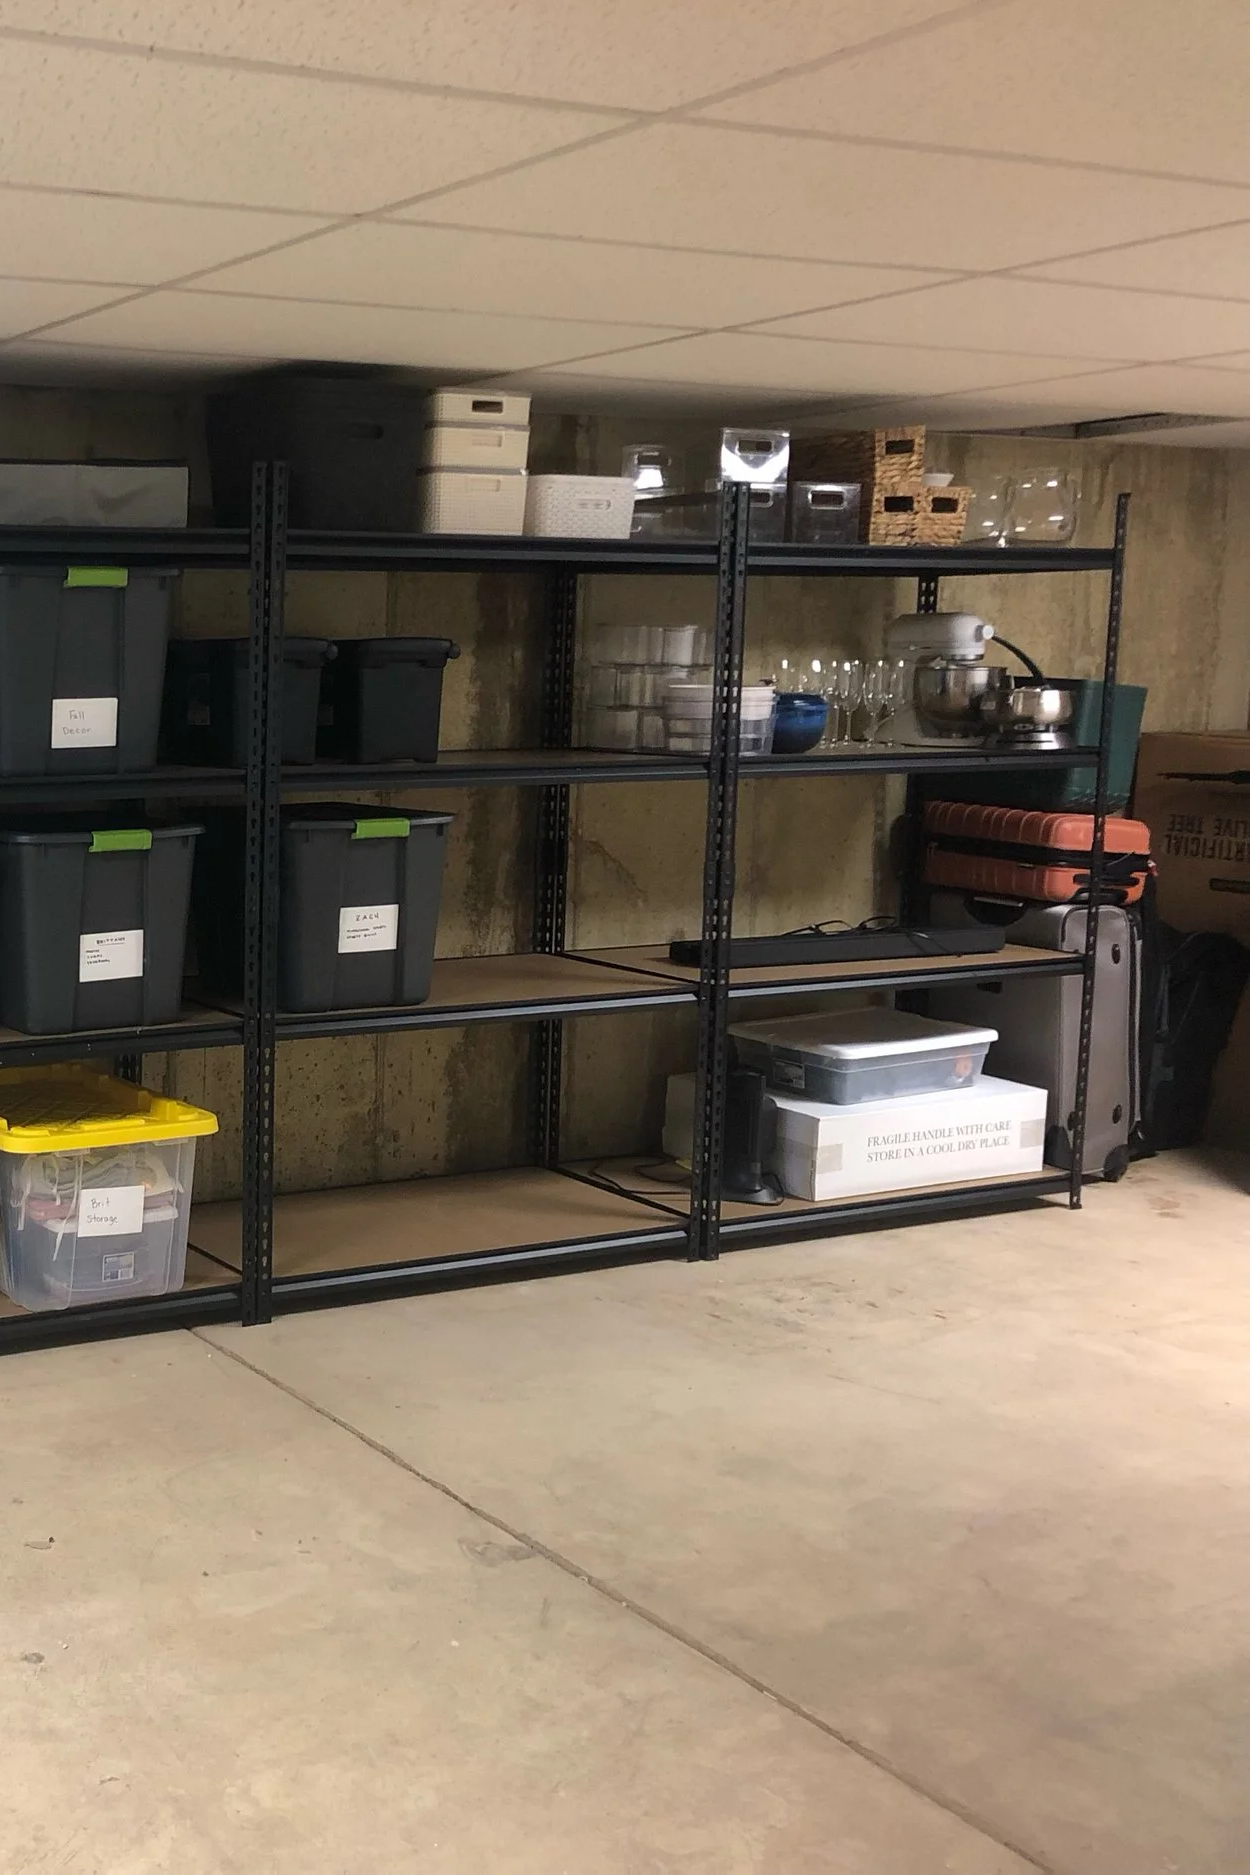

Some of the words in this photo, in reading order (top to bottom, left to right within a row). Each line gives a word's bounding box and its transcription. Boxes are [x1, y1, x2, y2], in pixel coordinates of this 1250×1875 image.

[69, 709, 85, 720] Fall
[62, 726, 91, 735] Decor
[1167, 813, 1204, 834] TREE
[355, 912, 379, 921] ZACH
[867, 1132, 911, 1147] FRAGILE
[912, 1127, 954, 1142] HANDLE
[955, 1123, 984, 1136] WITH
[985, 1120, 1012, 1132] CARE
[867, 1148, 902, 1162] STORE
[904, 1147, 915, 1159] IN
[916, 1147, 925, 1157] A
[926, 1142, 956, 1155] COOL
[956, 1139, 979, 1152] DRY
[979, 1135, 1010, 1149] PLACE
[91, 1197, 110, 1209] Brit
[87, 1214, 118, 1226] Storage
